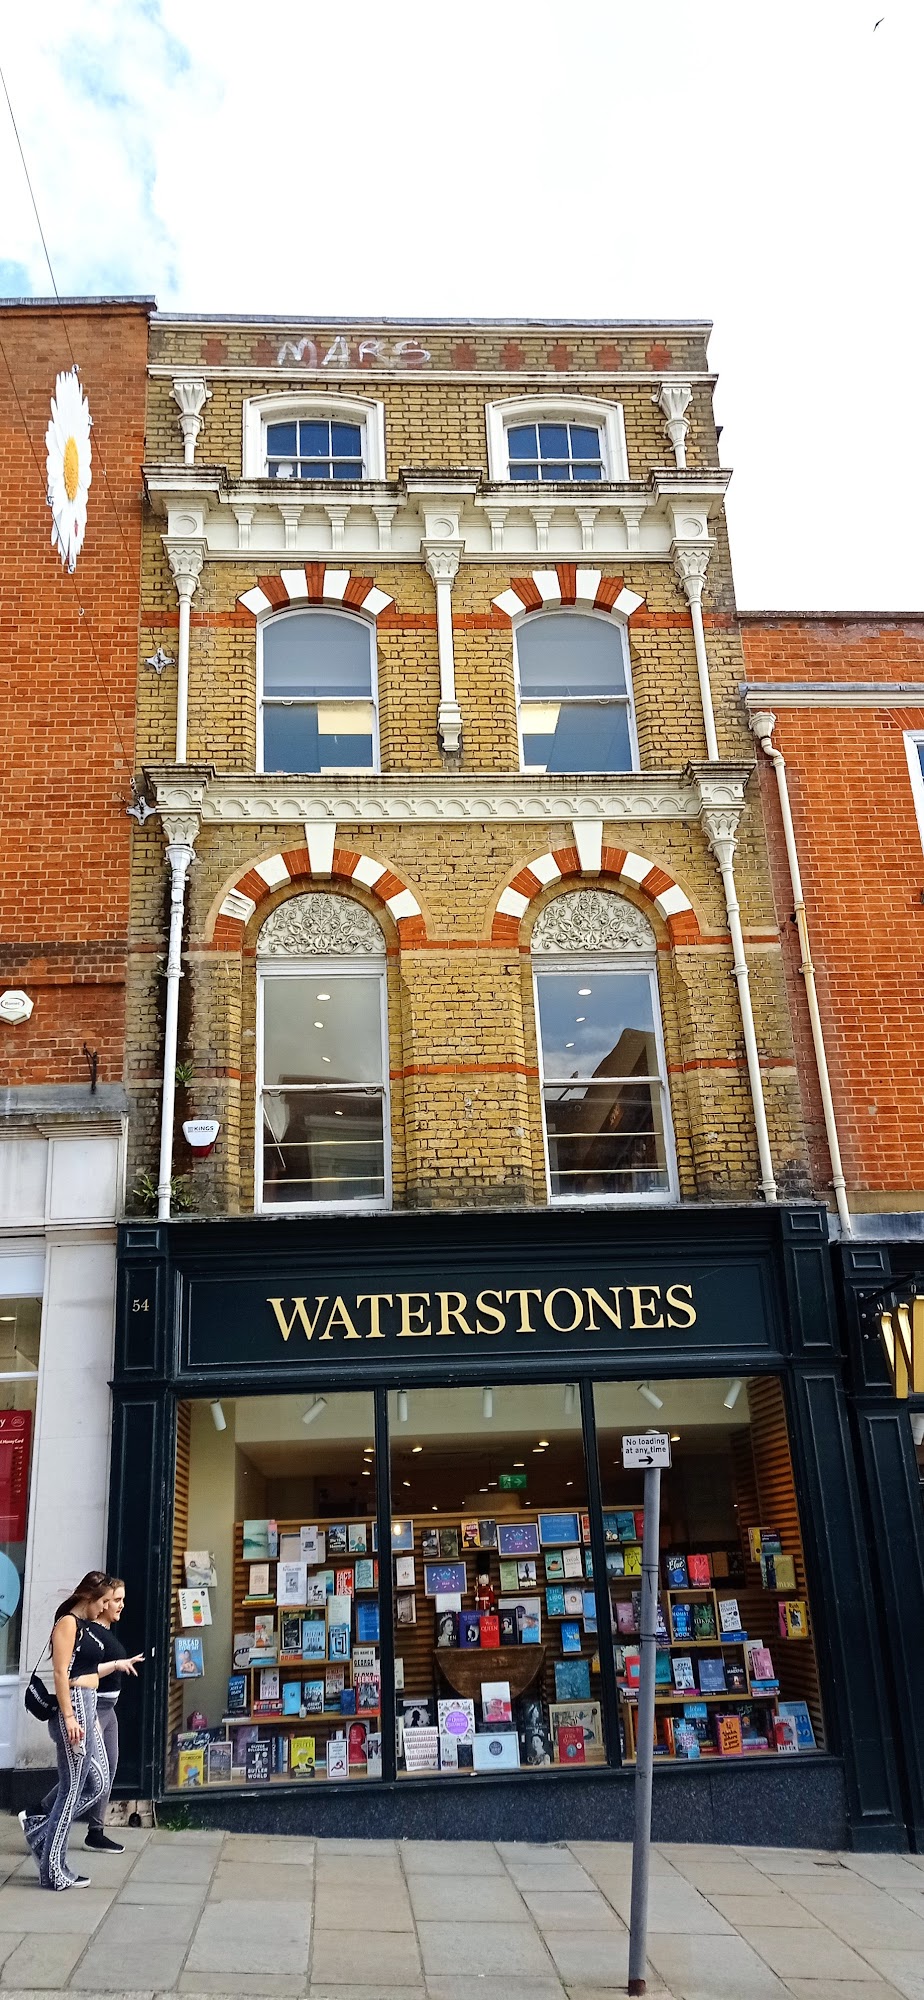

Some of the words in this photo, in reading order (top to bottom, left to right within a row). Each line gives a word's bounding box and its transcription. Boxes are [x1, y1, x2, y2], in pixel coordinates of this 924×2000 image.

[277, 336, 431, 367] MARS
[132, 1299, 150, 1312] 54
[266, 1284, 697, 1341] WATERSTONES
